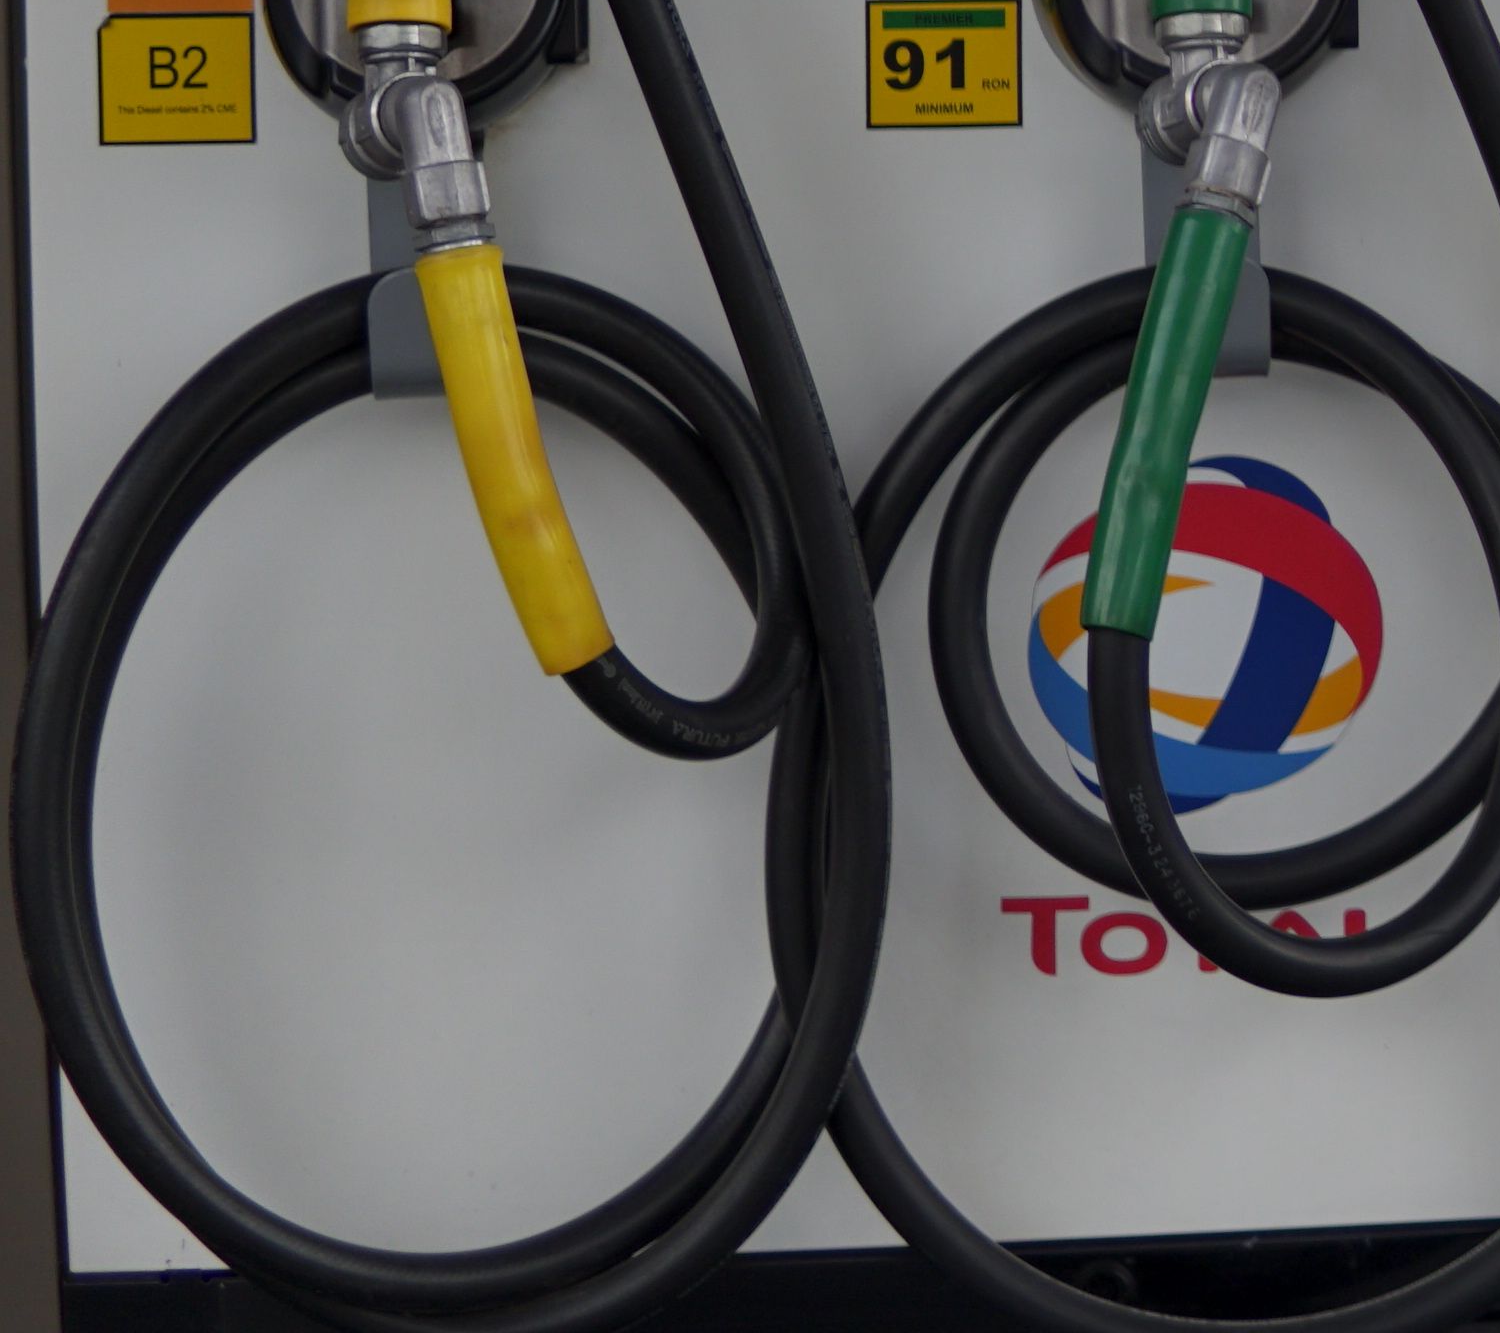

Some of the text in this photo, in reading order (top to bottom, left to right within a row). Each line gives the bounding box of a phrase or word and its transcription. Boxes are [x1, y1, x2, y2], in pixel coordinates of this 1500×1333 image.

[915, 13, 973, 24] PREMIER
[149, 45, 208, 89] B2
[884, 38, 1010, 91] 91 RON
[916, 103, 974, 115] MINIMUM
